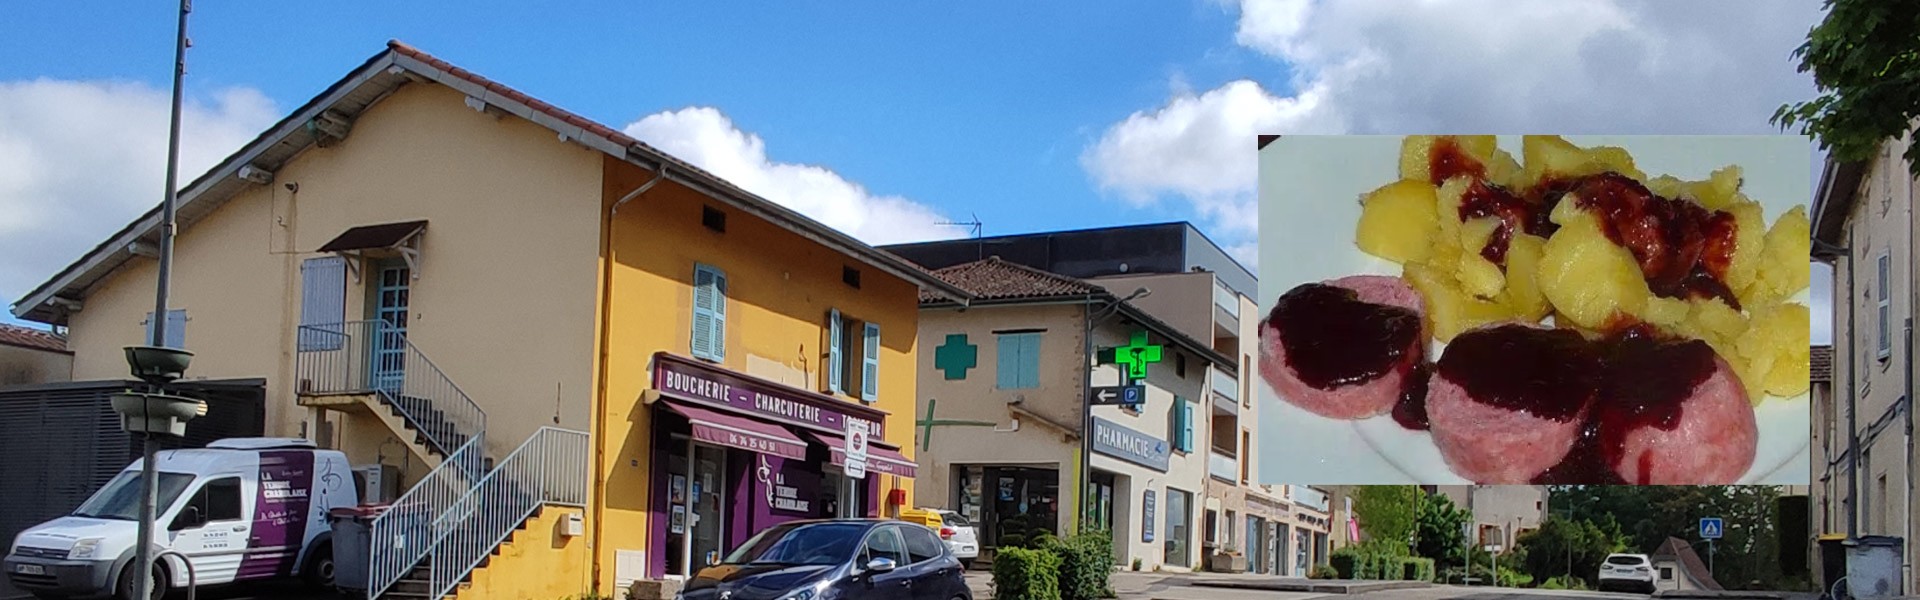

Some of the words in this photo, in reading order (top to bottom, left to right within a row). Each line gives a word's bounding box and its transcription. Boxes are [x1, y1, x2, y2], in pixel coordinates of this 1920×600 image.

[666, 371, 731, 402] BOUCHERIE
[755, 393, 821, 423] CHARCUTERIE
[1096, 425, 1149, 458] PHARMACIE
[775, 472, 785, 485] LA
